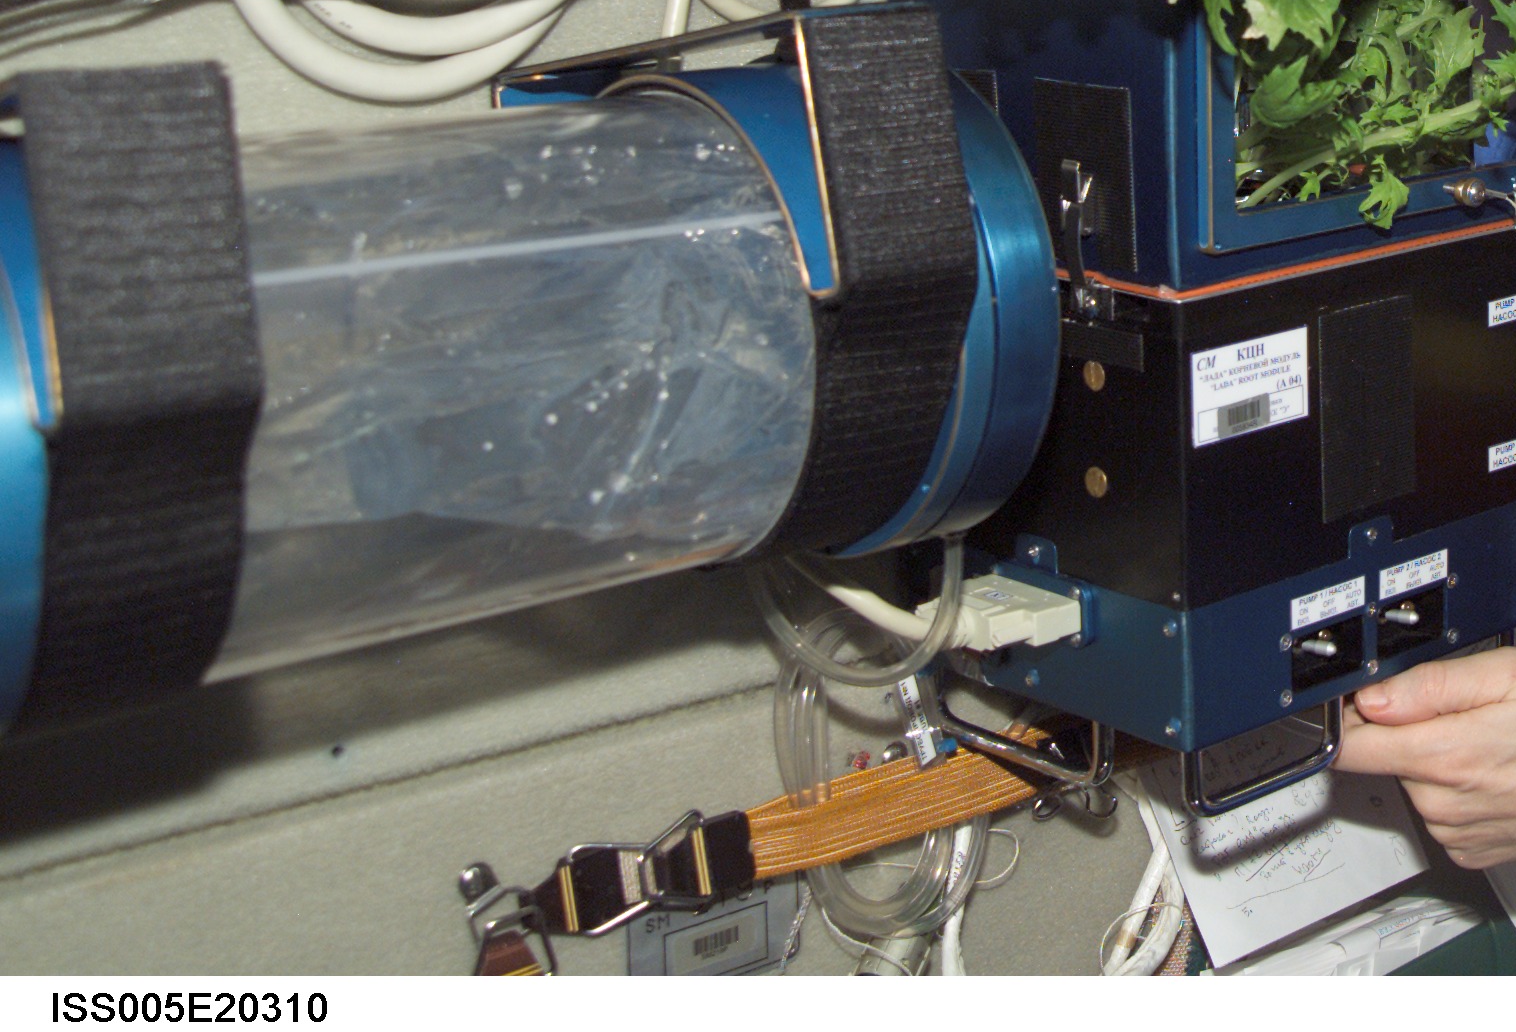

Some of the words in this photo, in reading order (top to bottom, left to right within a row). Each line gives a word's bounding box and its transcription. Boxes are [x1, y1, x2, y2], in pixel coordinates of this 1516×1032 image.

[1495, 298, 1515, 311] PUMP
[1237, 343, 1265, 362] КЦН
[1228, 358, 1269, 377] КОРНЕВОЙ
[1270, 352, 1301, 365] МОДУЛЬ
[1238, 373, 1260, 385] ROOT
[1260, 365, 1291, 378] MODULE
[1495, 442, 1515, 456] PUMP
[1298, 594, 1318, 607] PUMP
[1328, 582, 1353, 596] НАСОС
[1345, 589, 1362, 600] AUTO
[645, 914, 670, 934] SM
